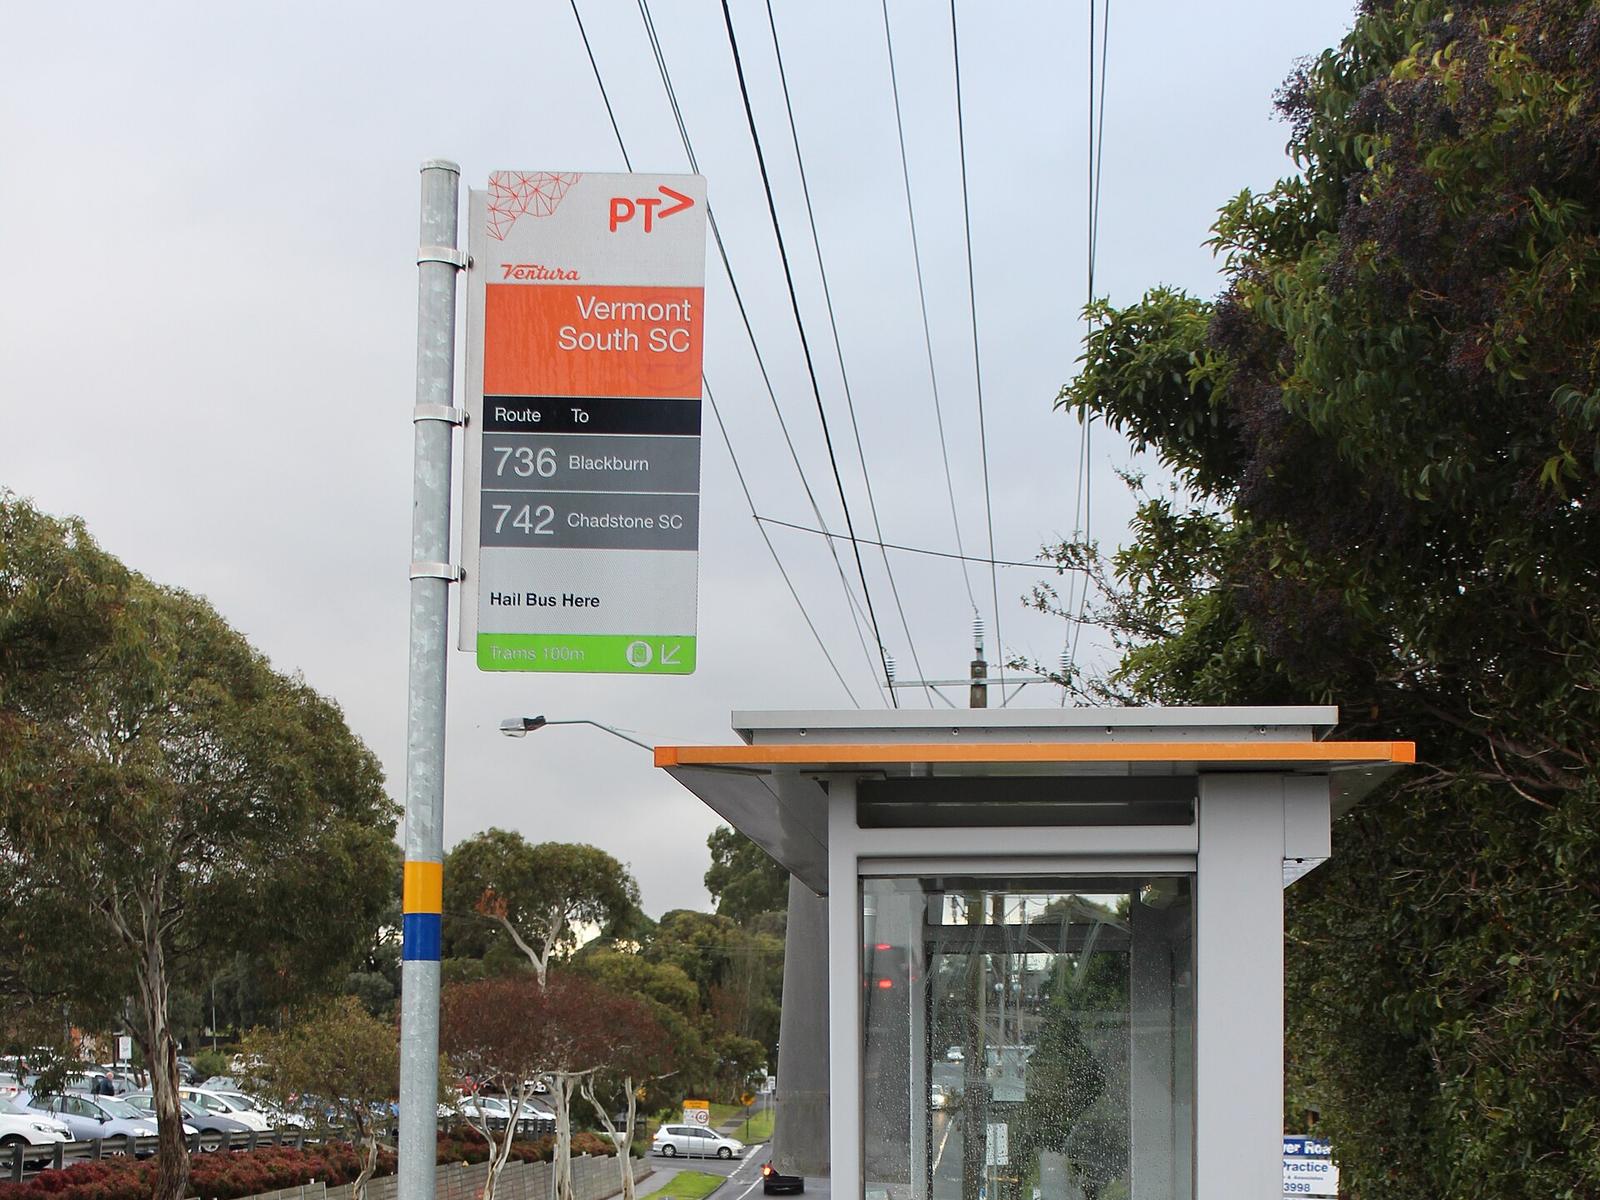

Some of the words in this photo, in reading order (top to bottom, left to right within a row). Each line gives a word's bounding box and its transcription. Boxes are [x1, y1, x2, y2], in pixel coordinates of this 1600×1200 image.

[500, 263, 582, 281] Ventura
[576, 295, 691, 322] Vermont
[558, 326, 639, 352] South
[648, 328, 691, 353] SC
[494, 408, 541, 423] Route
[571, 408, 590, 423] To
[493, 446, 557, 478] 736
[569, 456, 649, 471] Blackburn
[492, 504, 555, 535] 742
[567, 513, 654, 528] Chadstone
[658, 514, 683, 529] SC
[490, 592, 521, 606] Hail
[526, 592, 557, 607] Bus
[562, 593, 600, 607] Here
[490, 644, 537, 660] Trams
[543, 646, 585, 661] 100m
[1284, 1182, 1311, 1192] 3998
